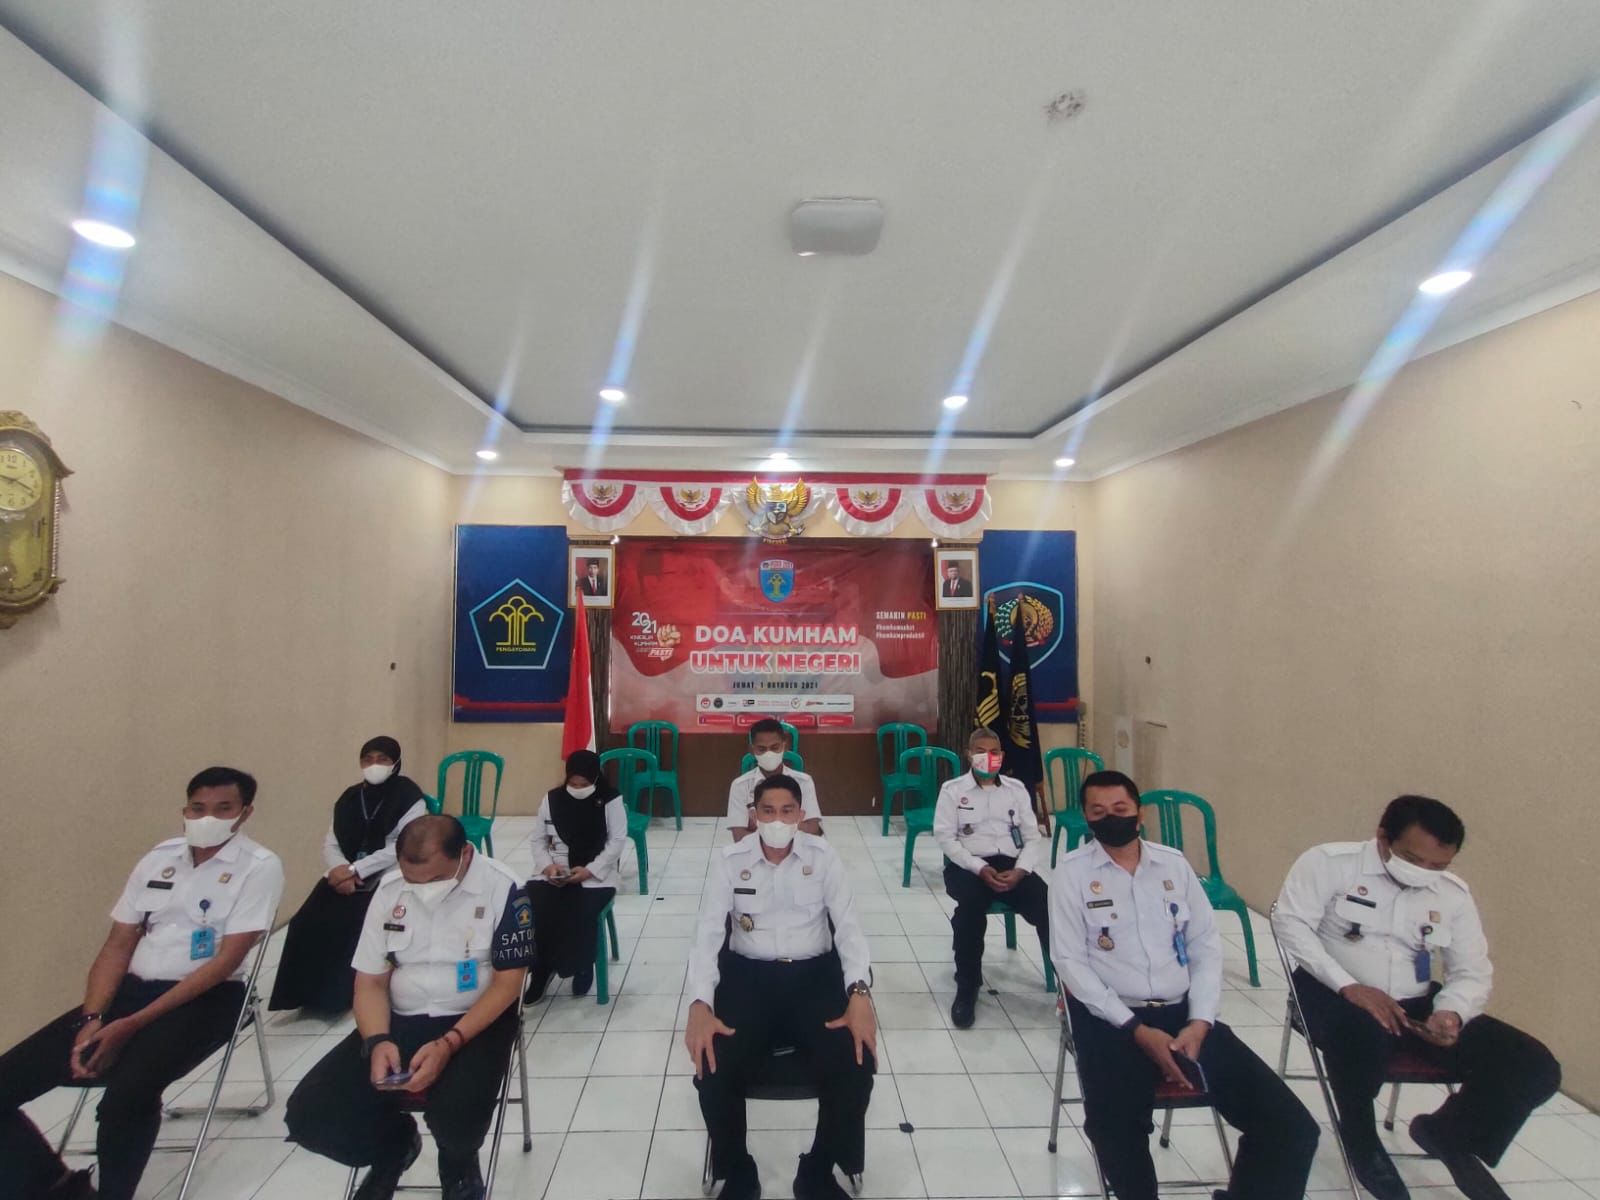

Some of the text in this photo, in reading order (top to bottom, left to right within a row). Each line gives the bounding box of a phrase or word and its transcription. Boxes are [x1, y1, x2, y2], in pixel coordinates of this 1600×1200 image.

[876, 611, 927, 620] SEMAKIN PASTI
[695, 625, 857, 644] DOA KUMHAM
[690, 651, 861, 674] UNTUK NEGERI
[801, 681, 818, 689] 2021
